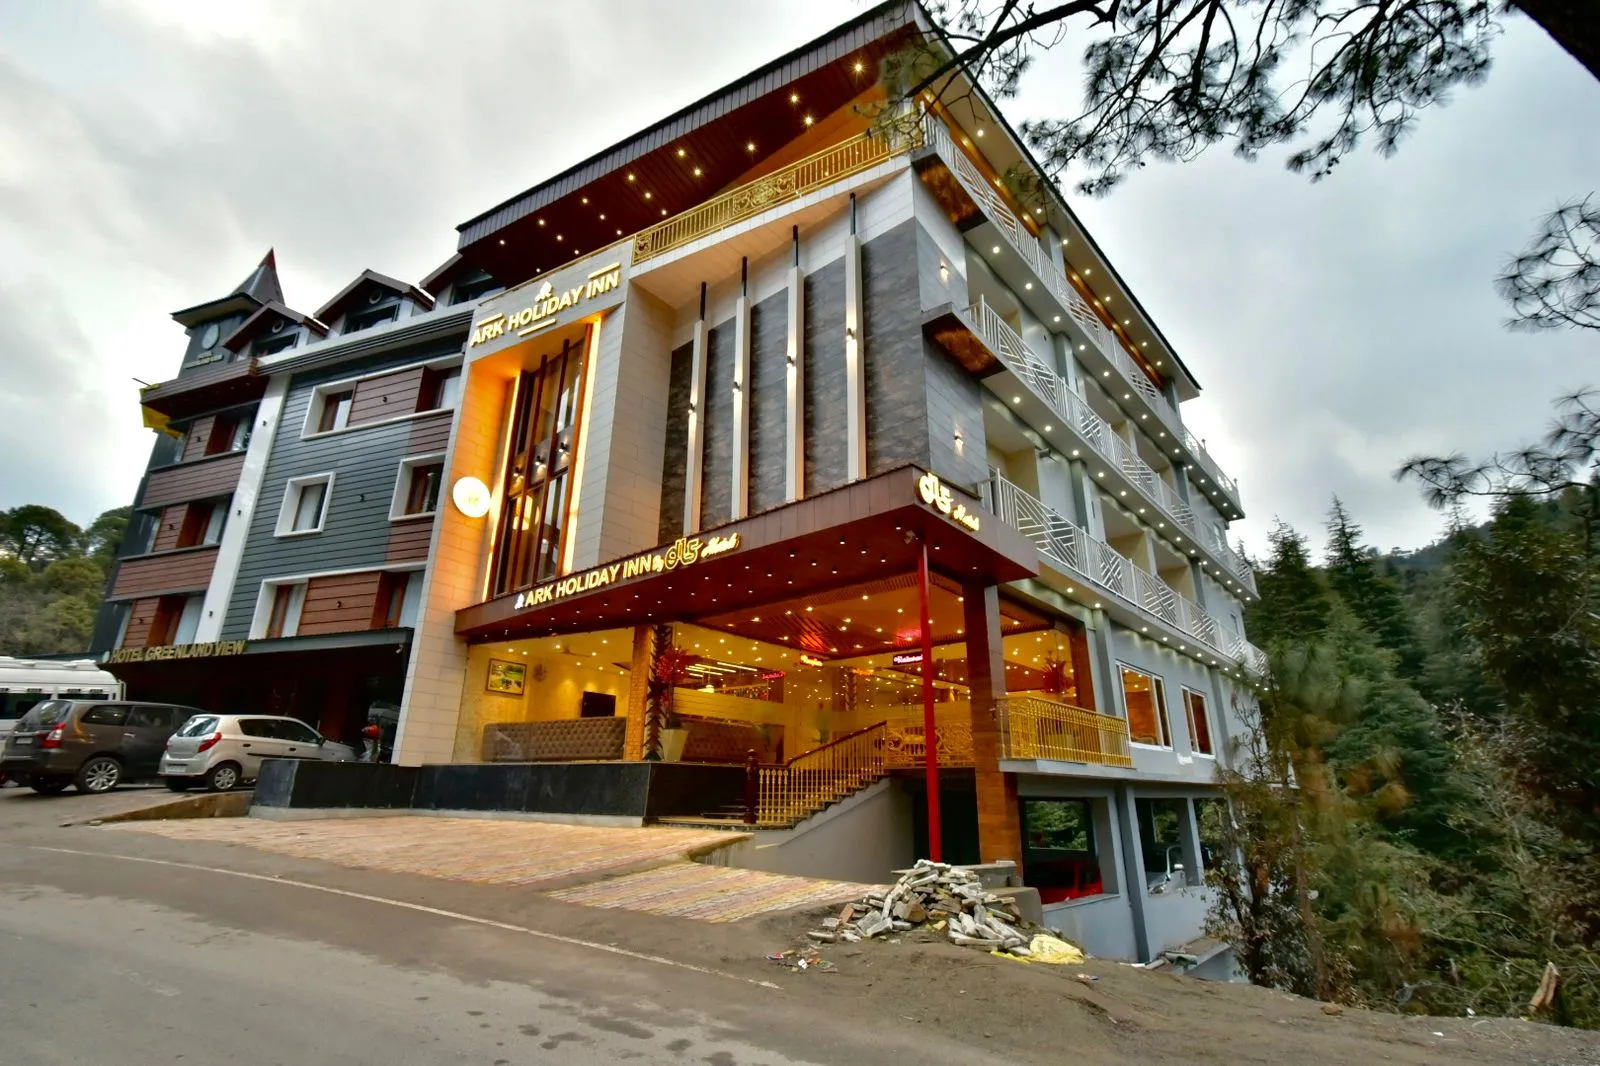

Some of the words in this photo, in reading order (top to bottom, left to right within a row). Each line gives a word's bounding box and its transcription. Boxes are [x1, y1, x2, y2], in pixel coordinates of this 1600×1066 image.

[470, 317, 506, 347] ARK
[508, 285, 585, 331] HOLIDAY
[586, 269, 620, 299] INN
[524, 585, 553, 608] ARK
[556, 564, 620, 598] HOLIDAY
[623, 554, 652, 579] INN
[110, 647, 144, 664] HOTEL
[144, 641, 213, 661] GREENLAND
[213, 640, 246, 656] VIEW
